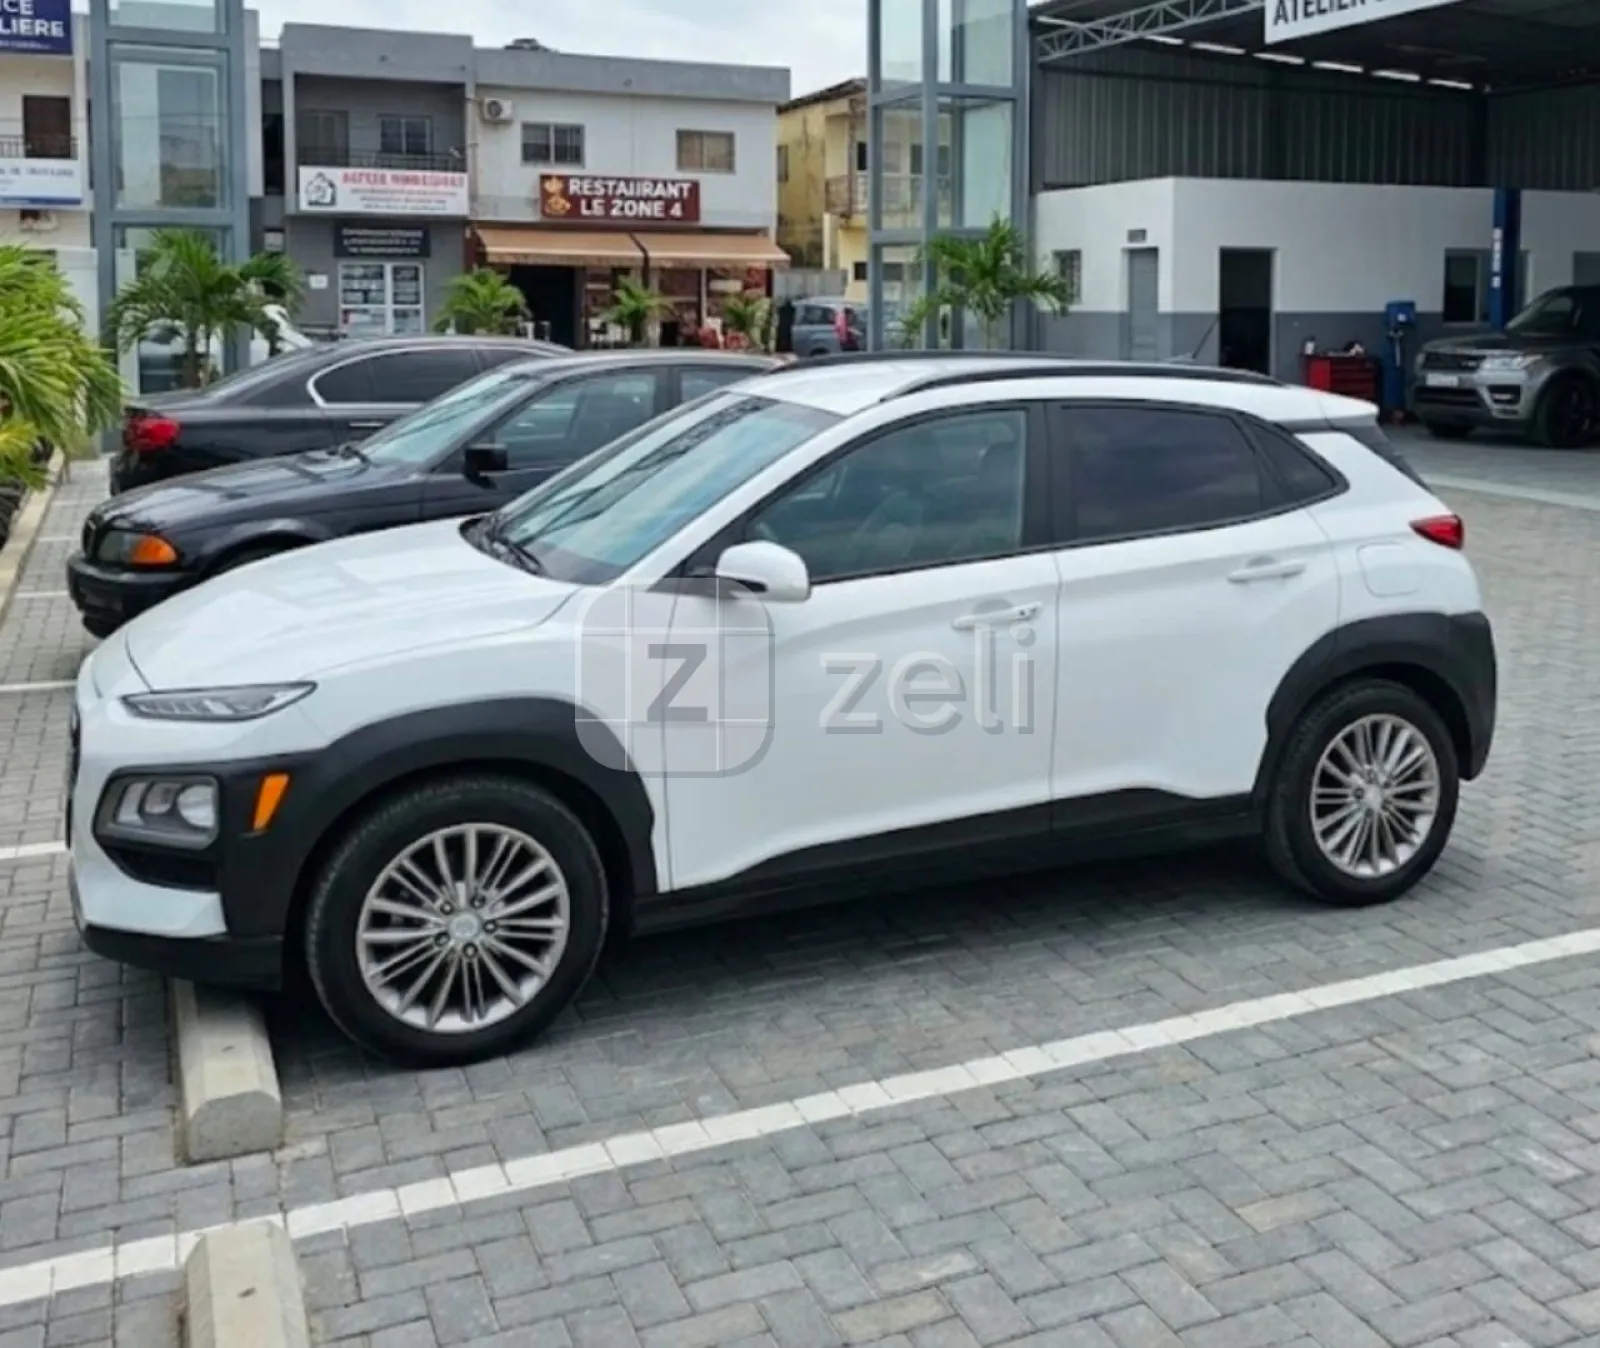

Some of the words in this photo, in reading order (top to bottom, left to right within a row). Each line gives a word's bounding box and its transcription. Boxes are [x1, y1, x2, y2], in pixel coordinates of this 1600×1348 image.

[0, 0, 34, 15] CE
[1273, 0, 1366, 26] ATEL
[580, 198, 605, 216] LE
[610, 199, 665, 218] ZONE
[669, 201, 683, 217] 4
